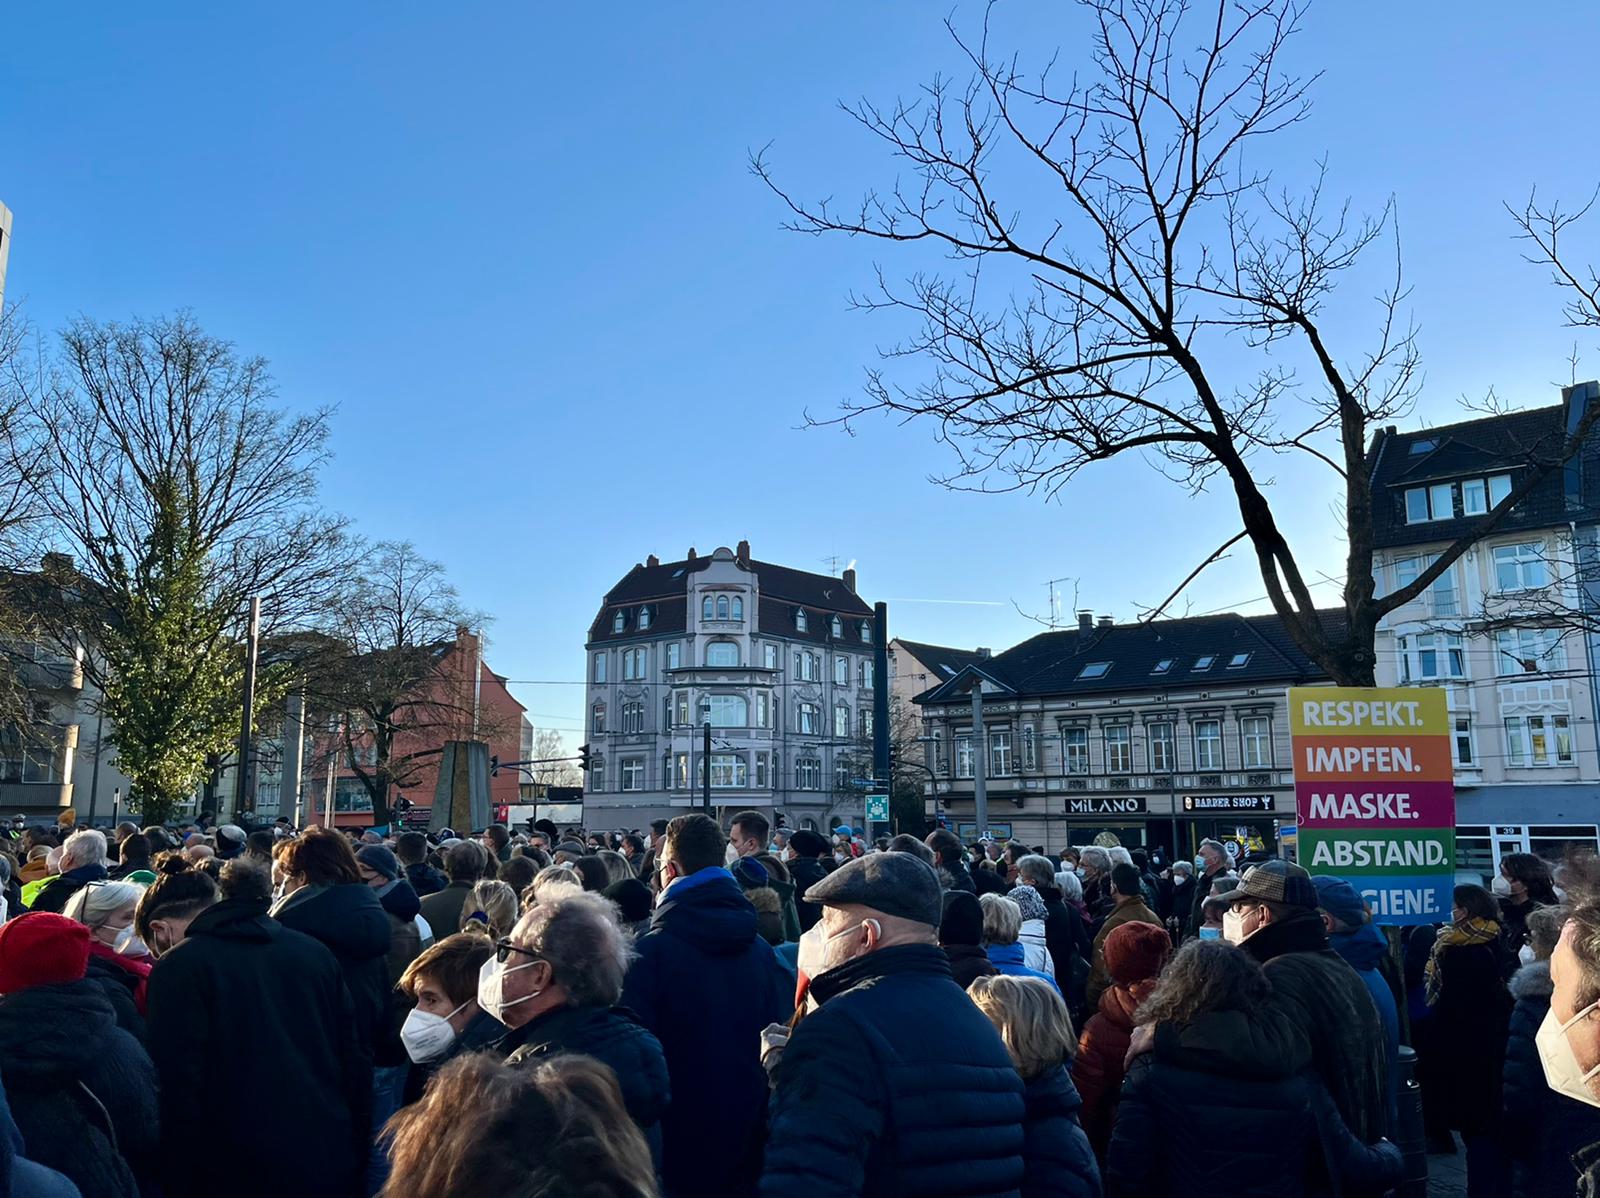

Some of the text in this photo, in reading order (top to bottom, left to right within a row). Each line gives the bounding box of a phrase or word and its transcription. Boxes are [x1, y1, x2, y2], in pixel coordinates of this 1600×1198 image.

[1303, 701, 1423, 727] RESPEKT.
[1306, 747, 1421, 773] IMPFEN.
[1195, 797, 1258, 808] BARBER SHOP
[1309, 793, 1420, 820] MASKE.
[1503, 827, 1514, 835] 39
[1311, 840, 1449, 867] ABSTAND.
[1360, 888, 1440, 916] GIENE.
